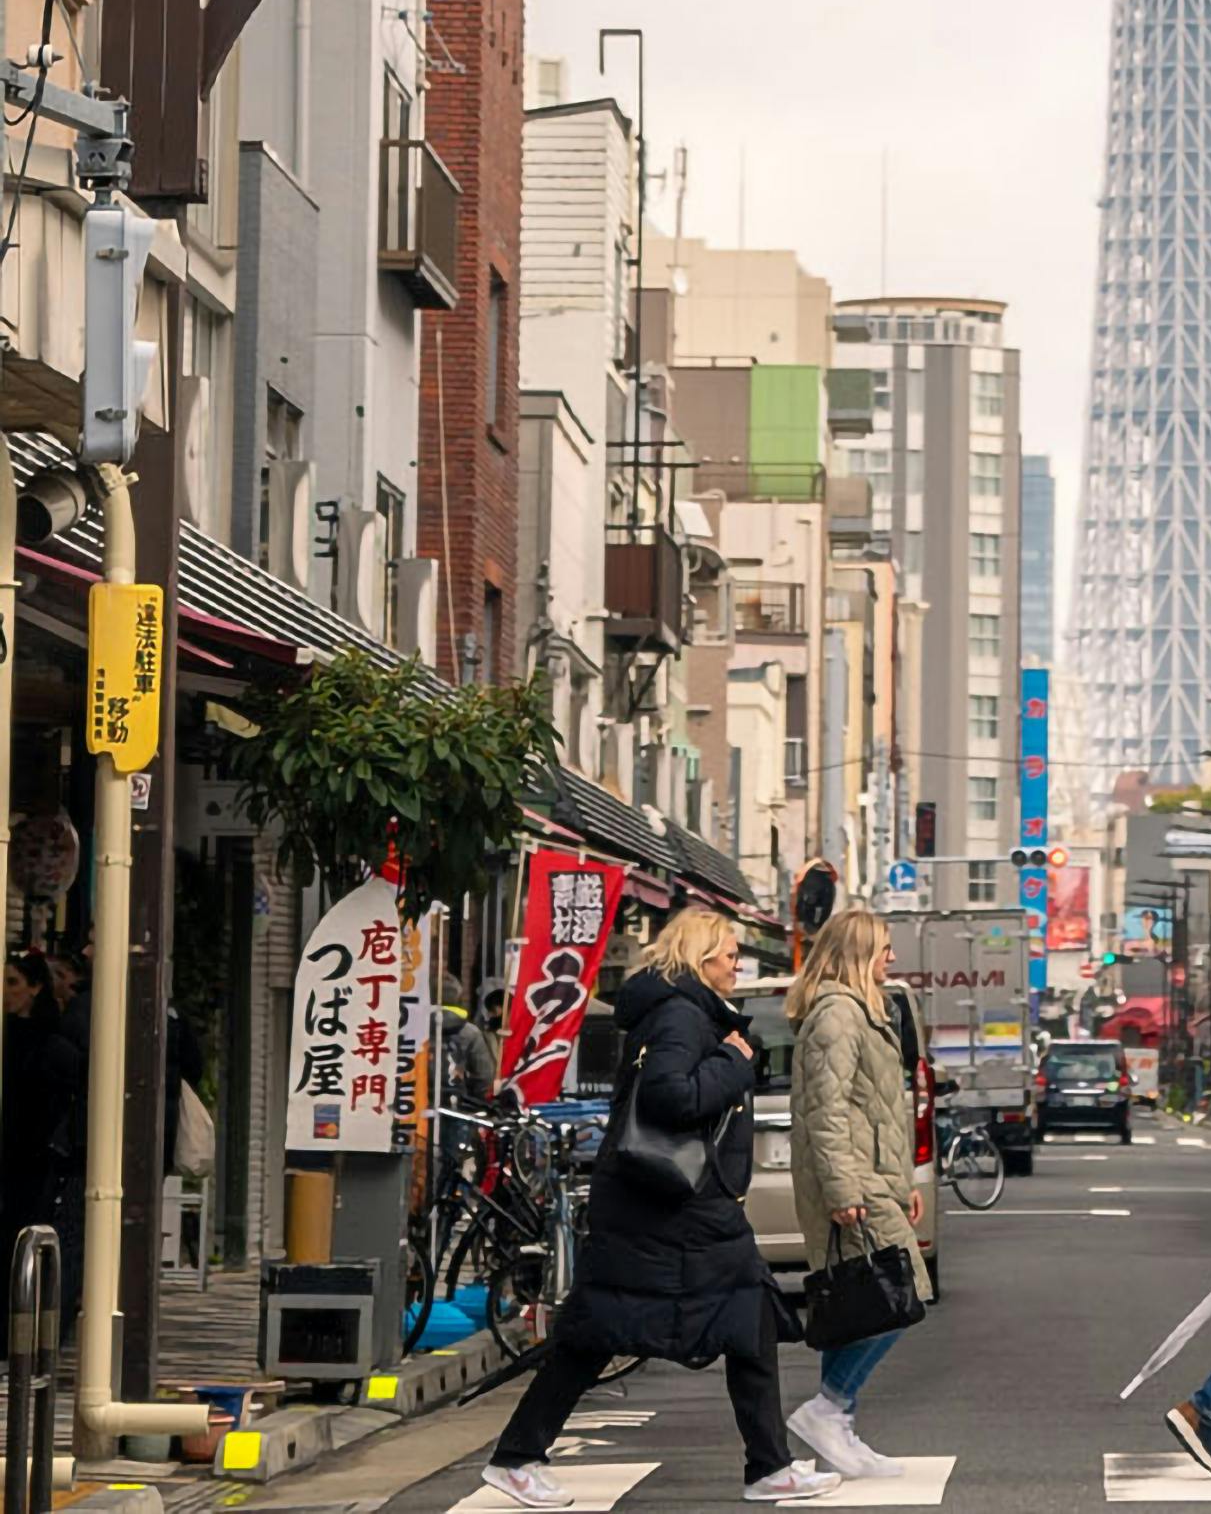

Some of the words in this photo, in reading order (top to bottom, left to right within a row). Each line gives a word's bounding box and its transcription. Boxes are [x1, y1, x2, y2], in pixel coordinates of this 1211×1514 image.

[107, 696, 130, 745] 移動
[294, 943, 353, 1098] つば屋
[350, 919, 399, 1115] 庖丁専門
